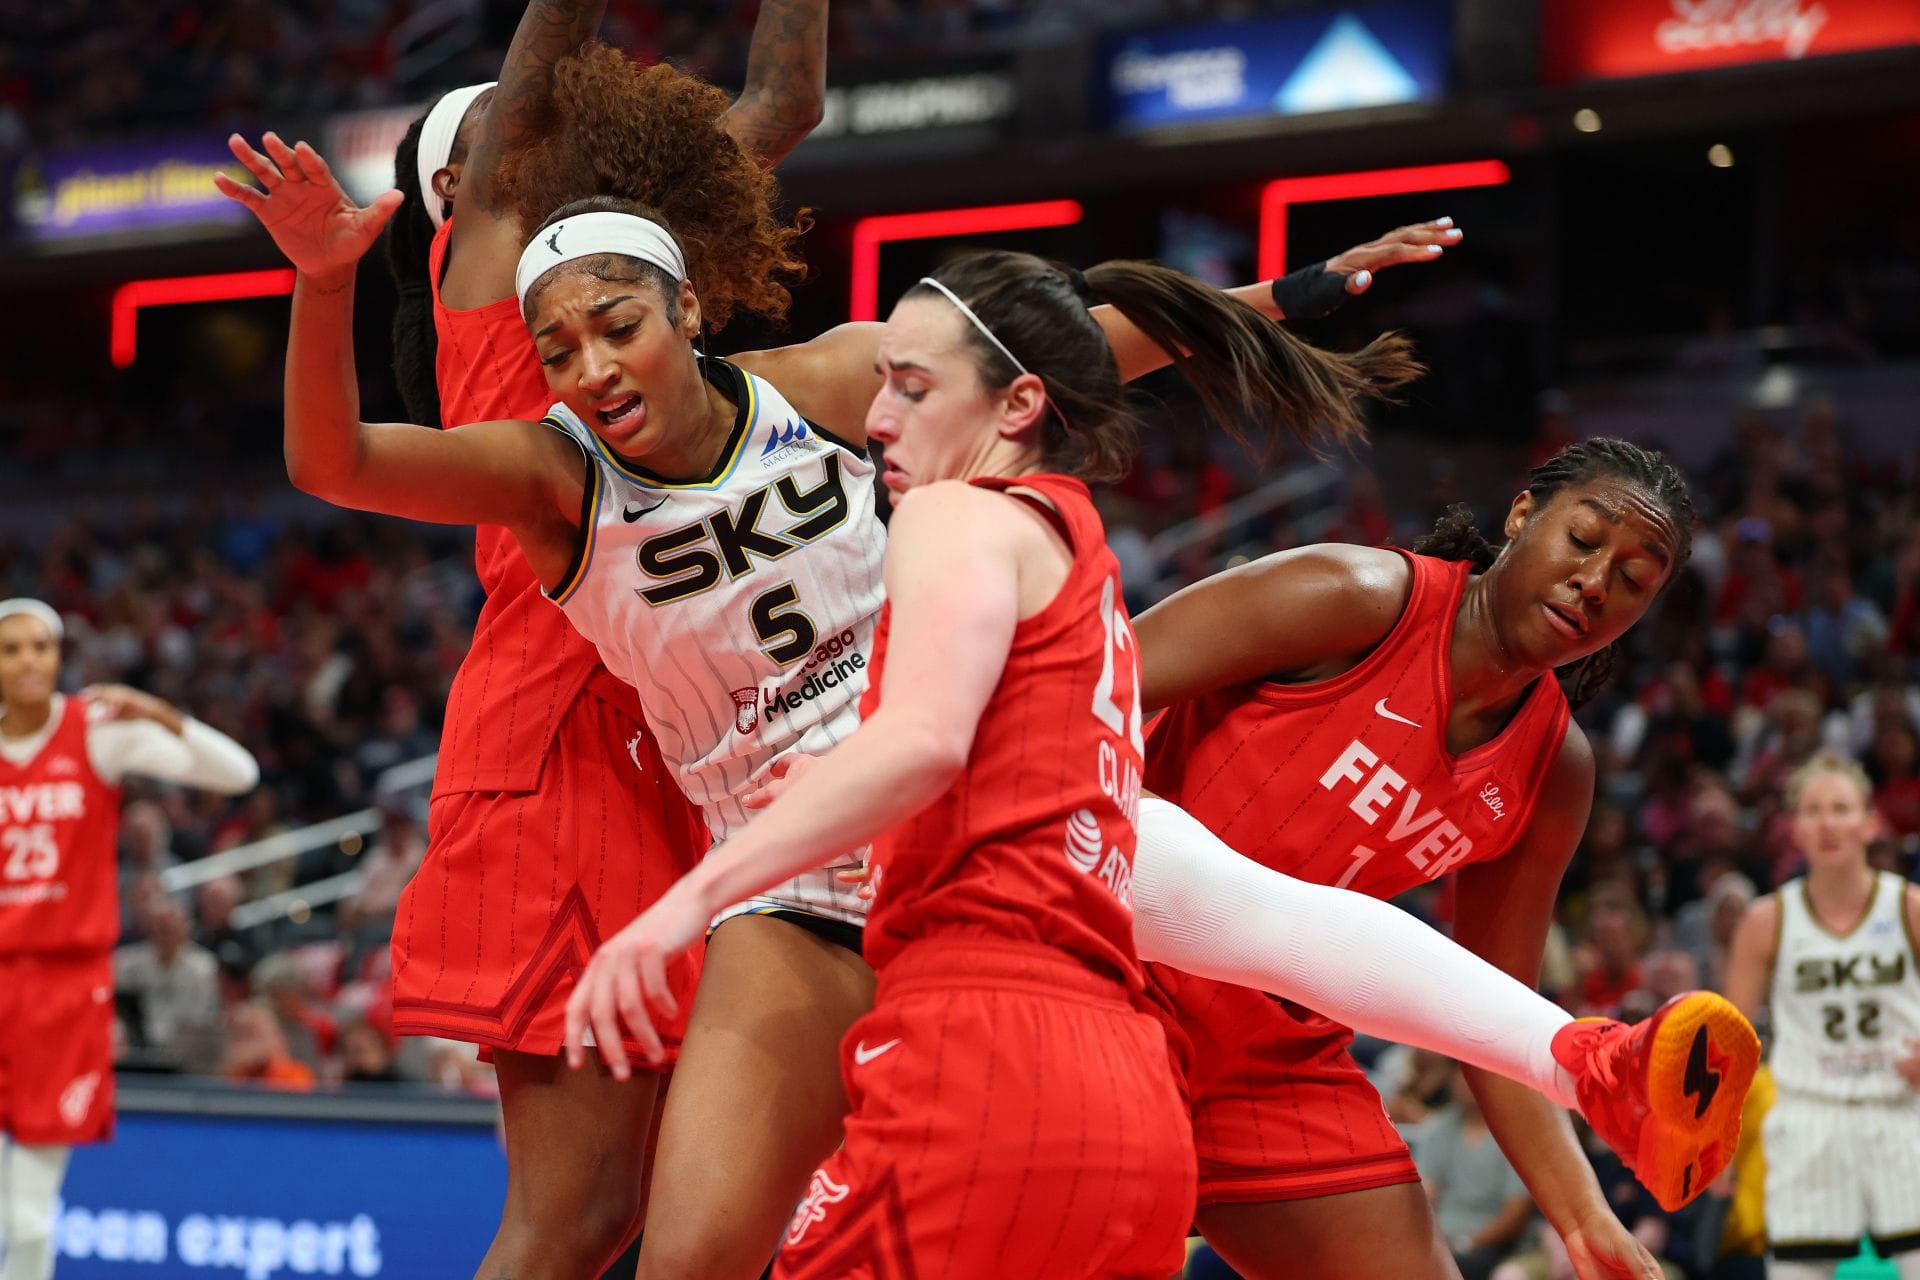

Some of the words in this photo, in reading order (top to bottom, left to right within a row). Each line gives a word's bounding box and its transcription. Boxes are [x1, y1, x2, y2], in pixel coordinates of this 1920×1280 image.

[635, 449, 849, 607] SKY
[748, 579, 818, 666] 5
[763, 652, 866, 723] Medicine
[1318, 738, 1474, 881] FEVER
[1479, 781, 1506, 822] Lilly
[2, 822, 59, 881] 25
[1796, 953, 1906, 993] SKY
[1823, 1000, 1881, 1042] 22
[175, 1212, 383, 1280] expert
